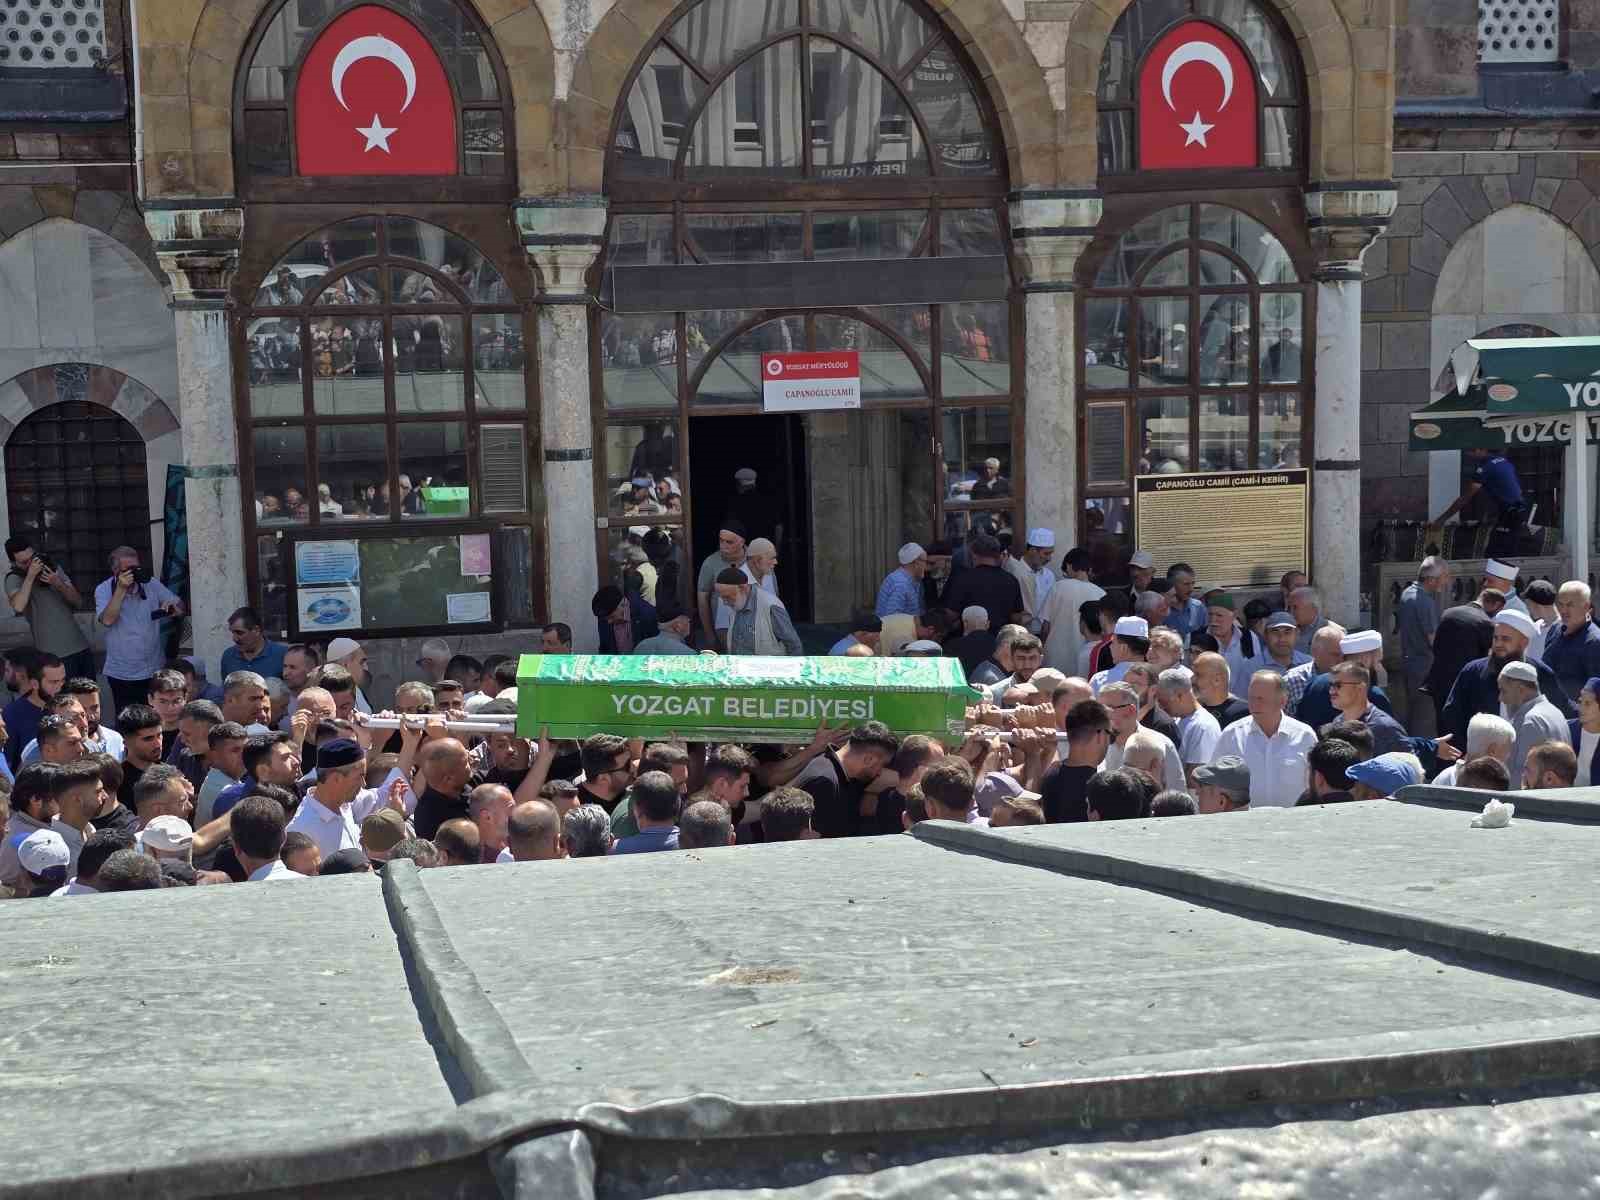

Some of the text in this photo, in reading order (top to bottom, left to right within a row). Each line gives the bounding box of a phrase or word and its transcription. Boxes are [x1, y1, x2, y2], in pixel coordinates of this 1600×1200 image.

[785, 387, 829, 399] ÇAPANOĞLU
[1155, 479, 1204, 490] ÇAPANOĞLU
[611, 694, 874, 720] YOZGAT BELEDİYESİ
